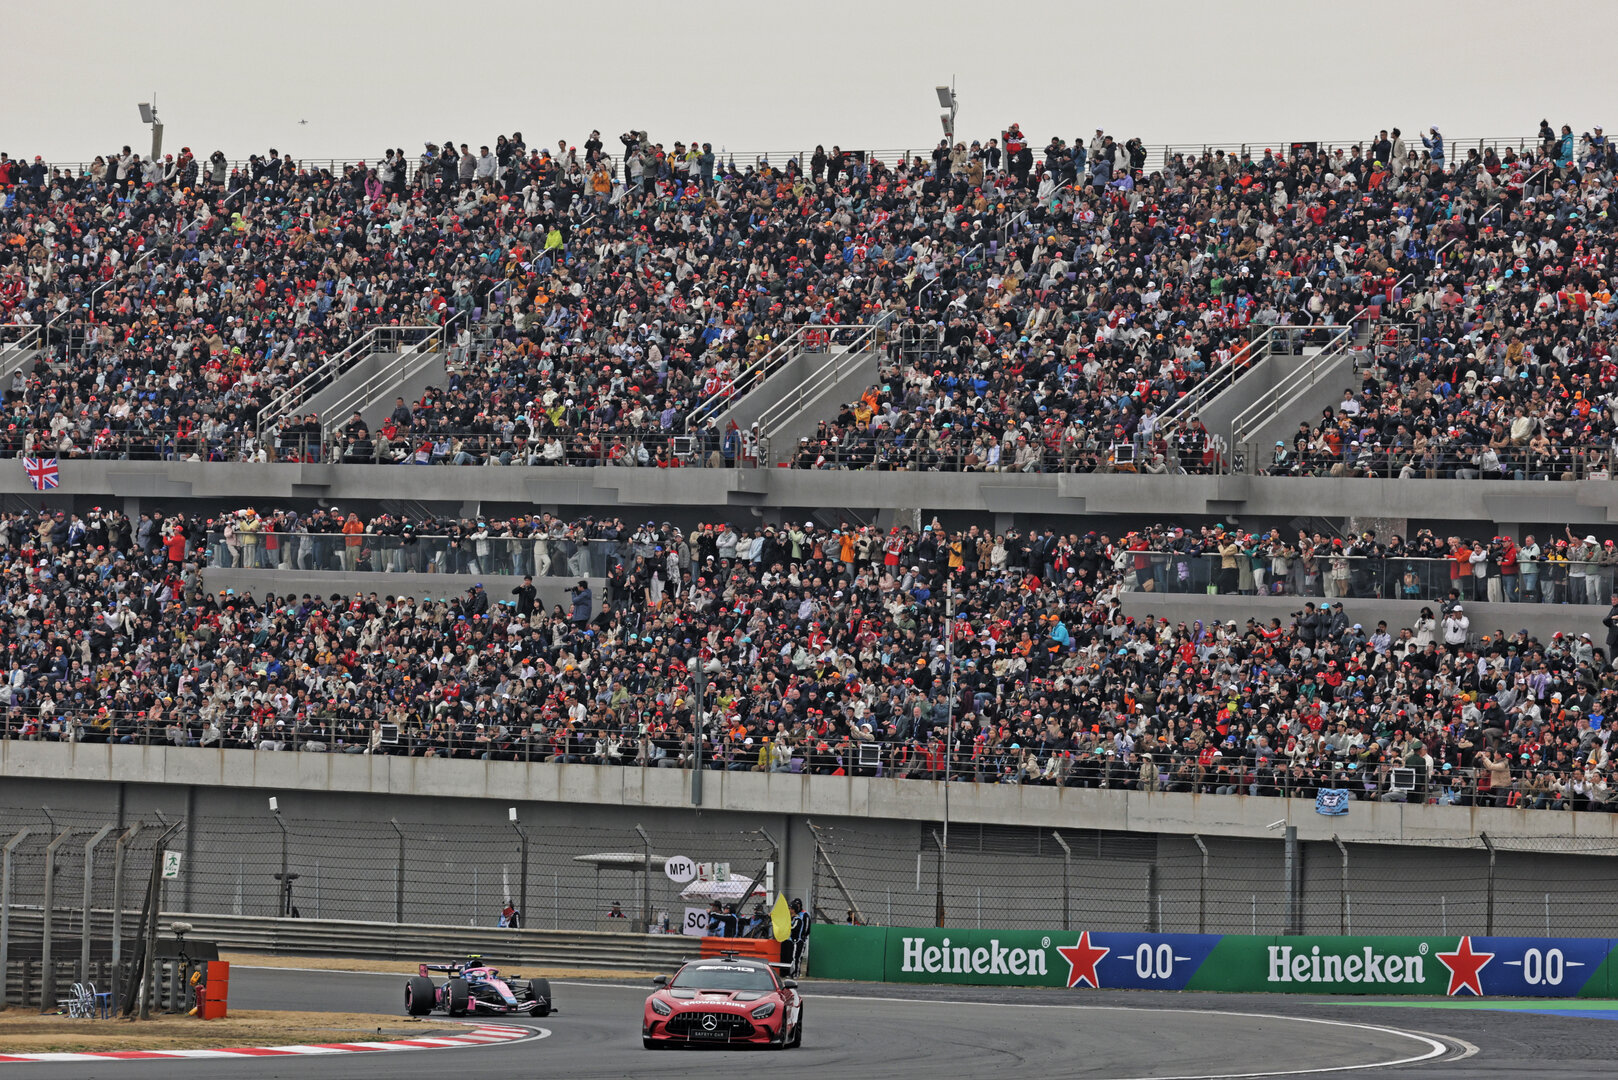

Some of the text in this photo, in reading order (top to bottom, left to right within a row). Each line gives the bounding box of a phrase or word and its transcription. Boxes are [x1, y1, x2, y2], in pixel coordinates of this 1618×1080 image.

[669, 863, 692, 876] MP1
[687, 912, 706, 929] SC
[1136, 943, 1173, 979] 0.0
[1523, 948, 1564, 986] 0.0
